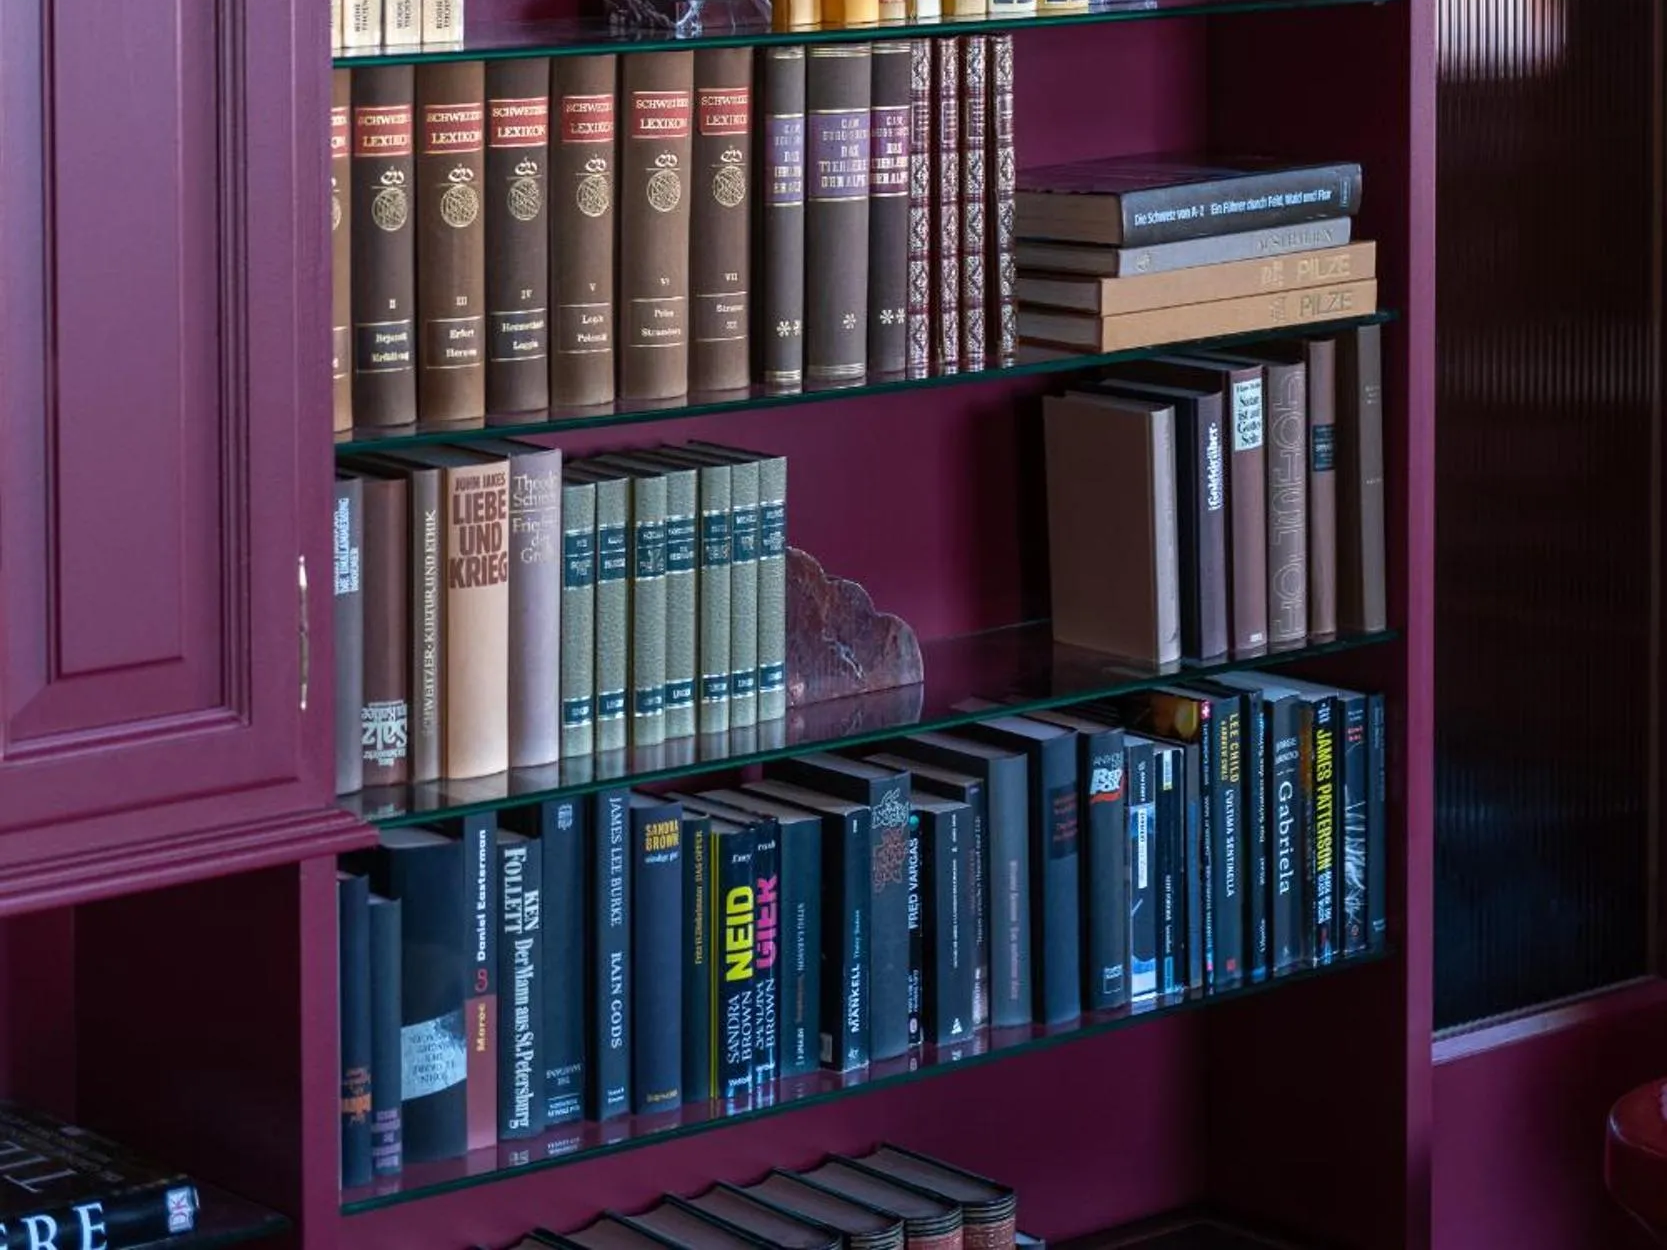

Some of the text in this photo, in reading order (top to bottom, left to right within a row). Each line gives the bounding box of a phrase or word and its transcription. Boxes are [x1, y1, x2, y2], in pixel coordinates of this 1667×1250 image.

[1134, 212, 1147, 227] Die
[1147, 209, 1176, 225] Schweiz
[1210, 202, 1223, 216] Ein
[1298, 254, 1351, 279] PILZE
[1300, 291, 1353, 317] PILZE
[424, 499, 437, 543] ETHIK
[452, 489, 507, 525] LIEBE
[458, 524, 502, 555] UND
[423, 544, 436, 578] UND
[449, 552, 508, 589] KRIEG
[1228, 712, 1240, 783] LEE CHILD
[1315, 729, 1333, 871] JAMES PATTERSON
[609, 797, 624, 927] JAMES LEE BURKE
[1278, 781, 1294, 896] Gabriela
[476, 829, 488, 962] Daniel Easterman
[504, 847, 524, 933] FOLLETT
[524, 890, 540, 930] KEN
[907, 838, 919, 930] FRED VARGAS
[511, 938, 532, 965] Der
[725, 885, 755, 983] NEID
[756, 874, 778, 970] GIER
[511, 965, 531, 1005] Mann
[609, 951, 622, 1049] RAIN GODS
[763, 978, 776, 1049] BROWN
[850, 963, 861, 1033] MANKELL
[727, 995, 741, 1065] SANDRA
[740, 990, 753, 1062] BROWN
